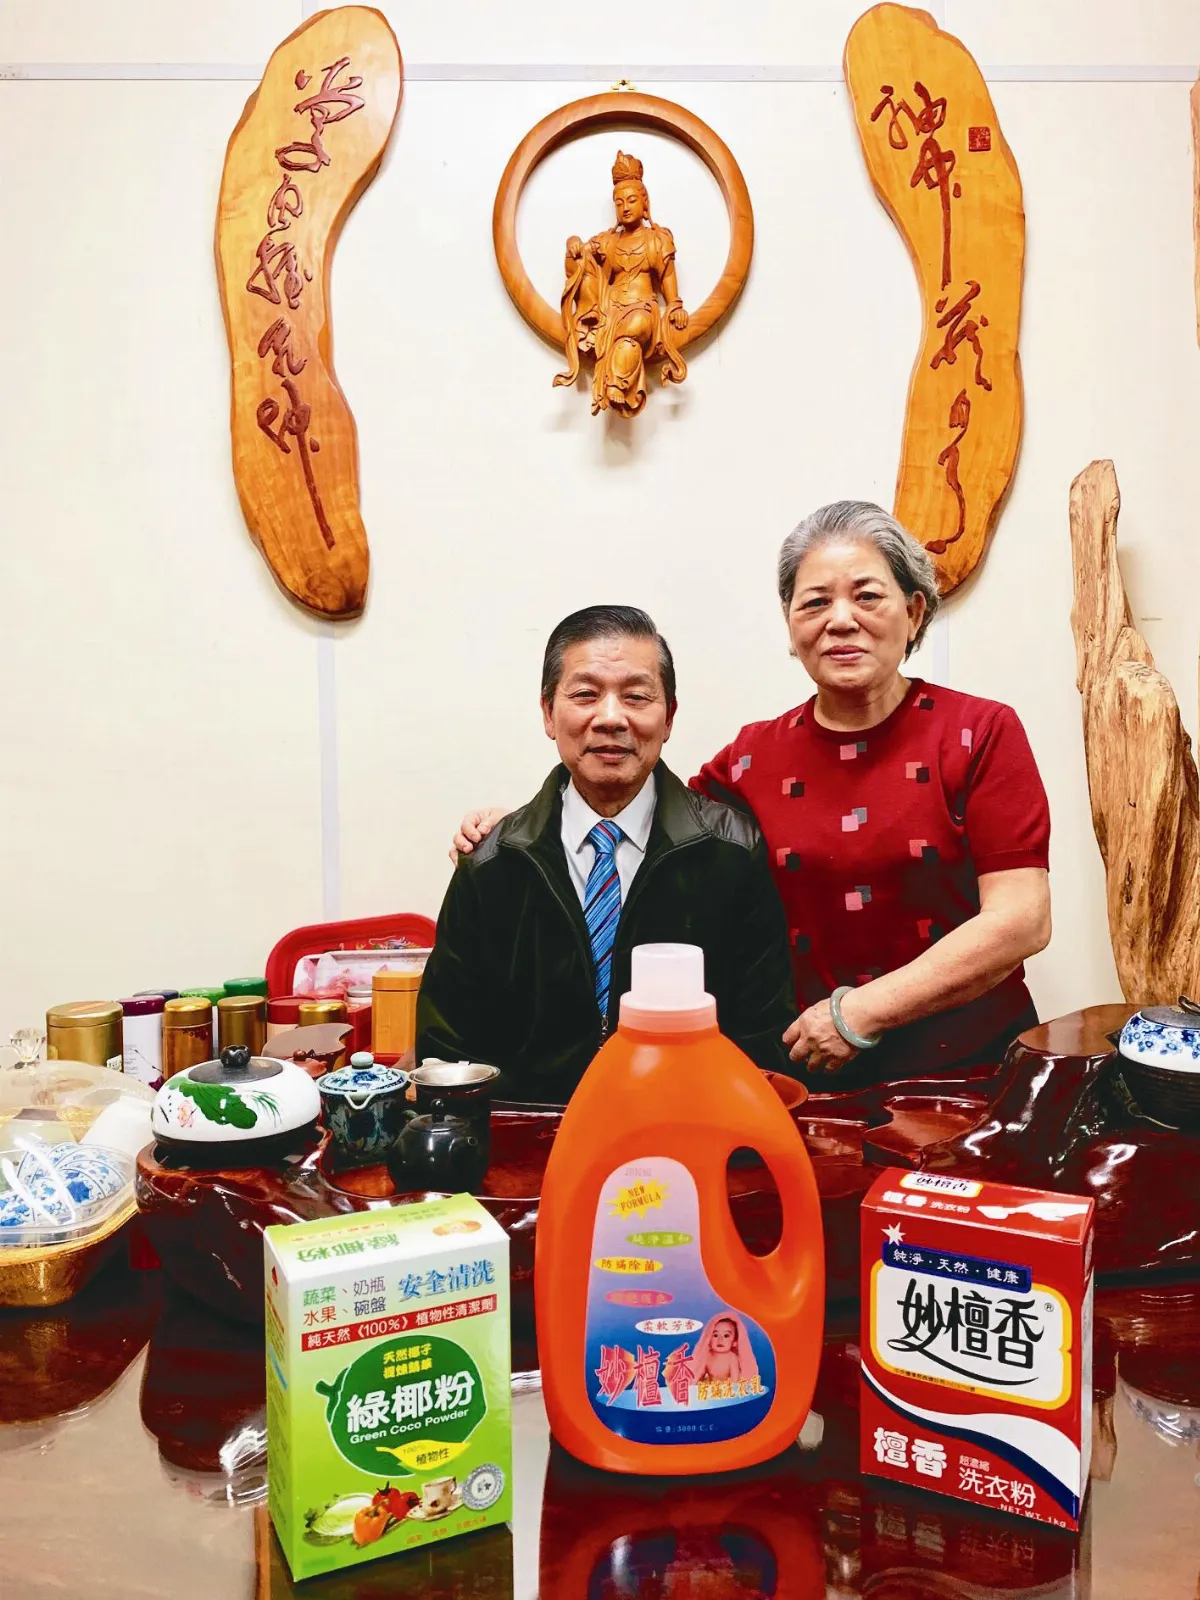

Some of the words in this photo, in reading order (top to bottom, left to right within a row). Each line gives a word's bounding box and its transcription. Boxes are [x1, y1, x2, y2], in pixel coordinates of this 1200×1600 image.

[620, 1192, 662, 1211] FORMULA
[627, 1185, 646, 1198] NEW
[398, 1259, 496, 1303] 安全清洗
[887, 1278, 1046, 1382] 妙檀香
[594, 1343, 696, 1408] 妙檀香
[345, 1369, 477, 1434] 綠椰粉
[349, 1429, 388, 1445] Green
[389, 1420, 423, 1435] Coco
[424, 1408, 470, 1427] Powder
[416, 1447, 450, 1466] 植物性
[873, 1426, 948, 1479] 檀香
[958, 1466, 1037, 1509] 洗衣粉
